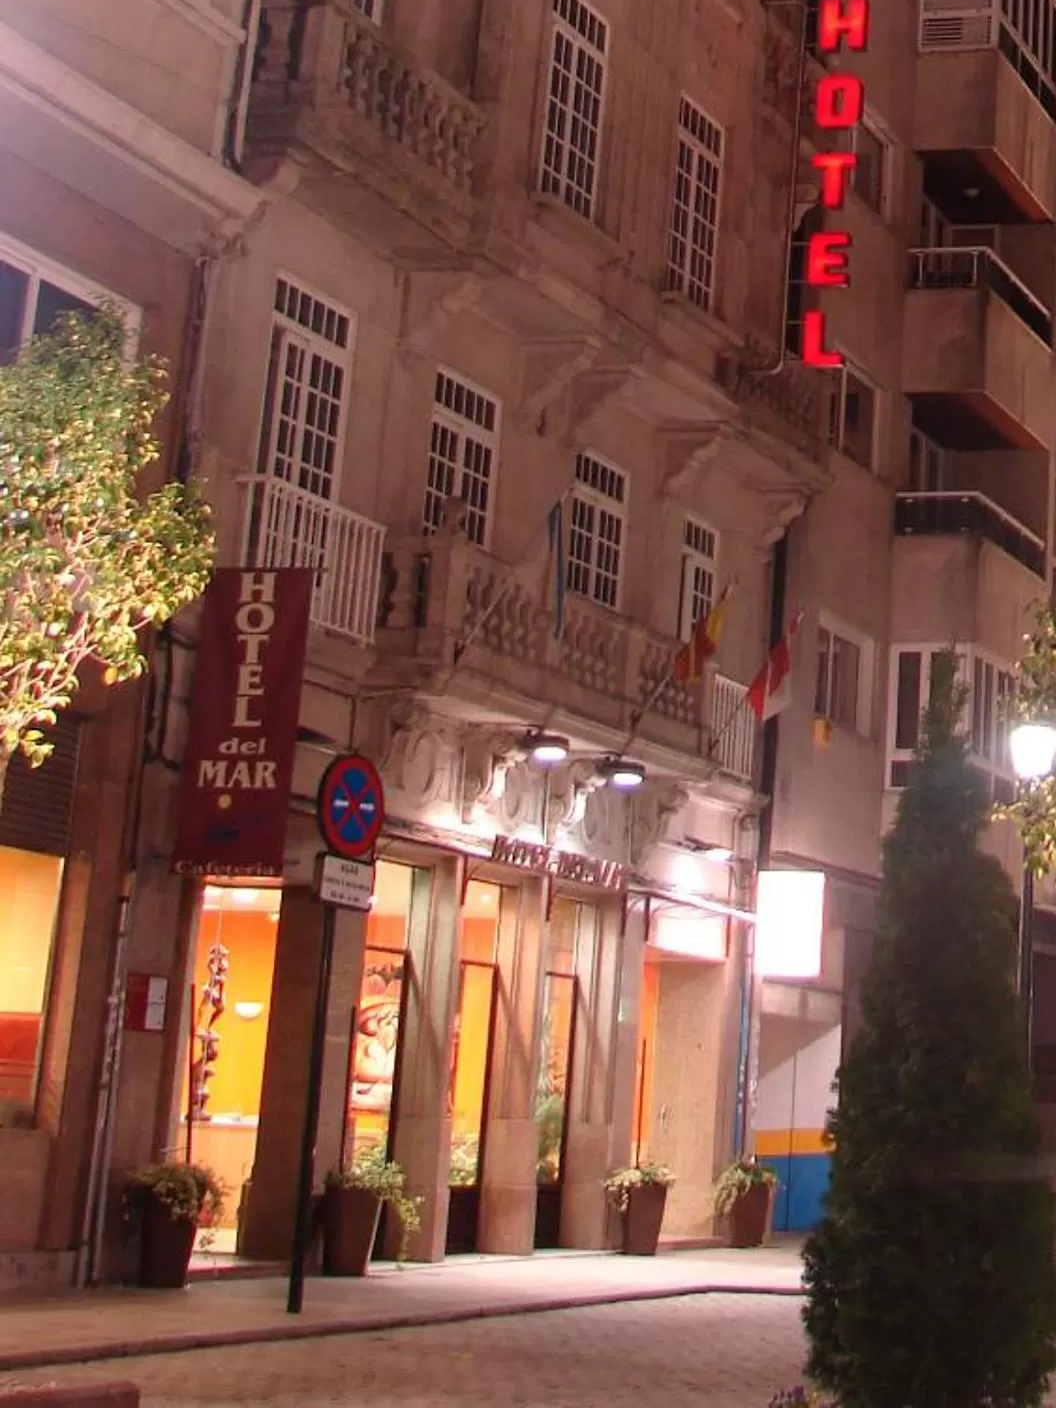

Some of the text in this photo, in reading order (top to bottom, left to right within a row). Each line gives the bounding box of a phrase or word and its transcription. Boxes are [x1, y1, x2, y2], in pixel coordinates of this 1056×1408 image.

[232, 573, 275, 728] HOTEL
[218, 737, 267, 754] del
[197, 760, 277, 789] MAR
